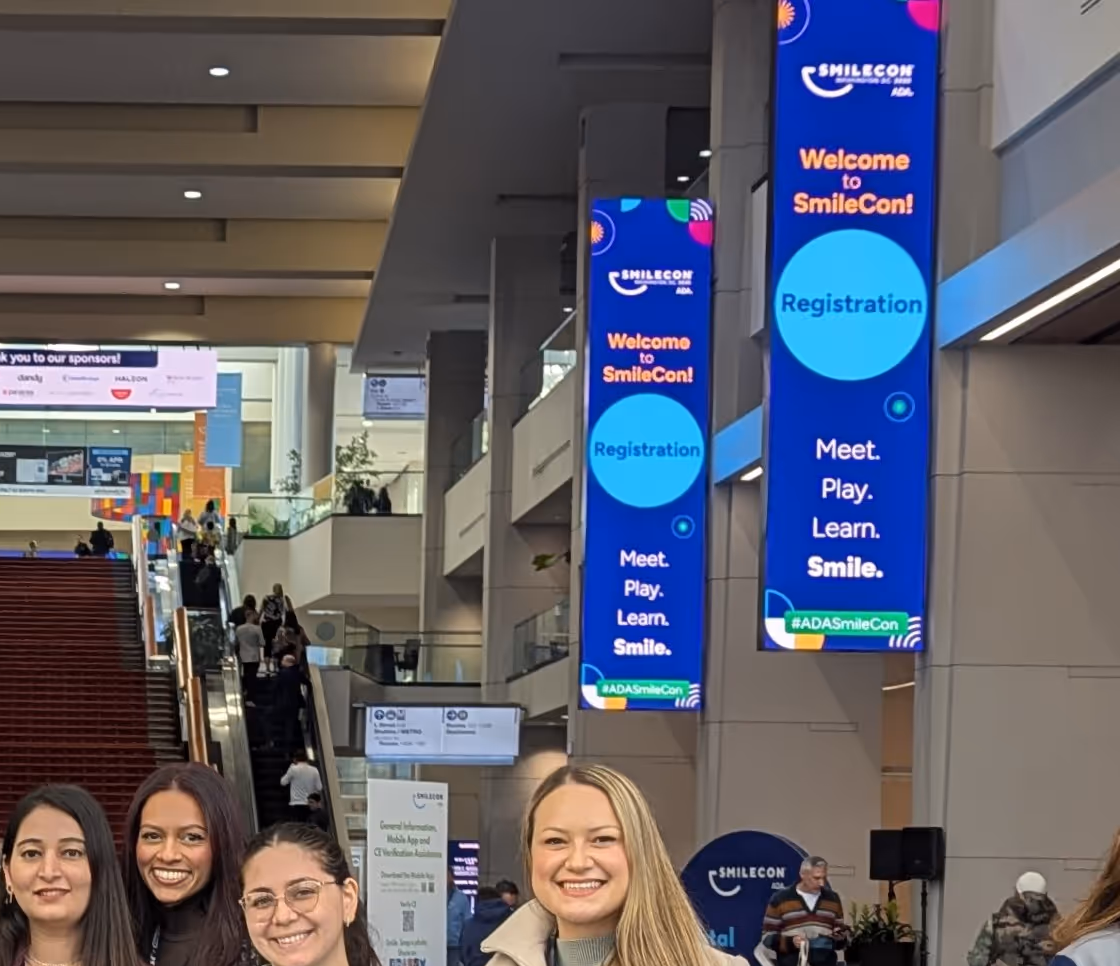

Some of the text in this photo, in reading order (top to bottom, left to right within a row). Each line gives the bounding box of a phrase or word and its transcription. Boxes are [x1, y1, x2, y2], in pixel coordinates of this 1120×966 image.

[818, 63, 914, 77] SMILECON
[800, 148, 910, 170] Welcome
[842, 174, 861, 189] to
[794, 192, 913, 214] SmileCon!
[621, 269, 693, 280] SMILECON
[782, 293, 922, 317] Registration
[608, 333, 691, 350] Welcome
[10, 354, 30, 365] you
[33, 353, 45, 363] to
[47, 355, 67, 363] our
[69, 353, 121, 365] sponsors!
[640, 353, 654, 364] to
[603, 366, 693, 383] SmileCon!
[595, 442, 700, 460] Registration
[817, 439, 880, 460] Meet.
[822, 478, 873, 504] Play.
[813, 517, 880, 538] Learn.
[620, 550, 669, 567] Meet.
[808, 556, 883, 578] Smile.
[625, 580, 663, 600] Play.
[617, 609, 669, 626] Learn.
[791, 616, 898, 631] #ADASmileCon
[614, 638, 671, 655] Smile.
[602, 683, 683, 696] #ADASmileCon
[380, 820, 402, 830] General
[387, 835, 430, 846] Mobile App and
[719, 867, 785, 879] SMILECON
